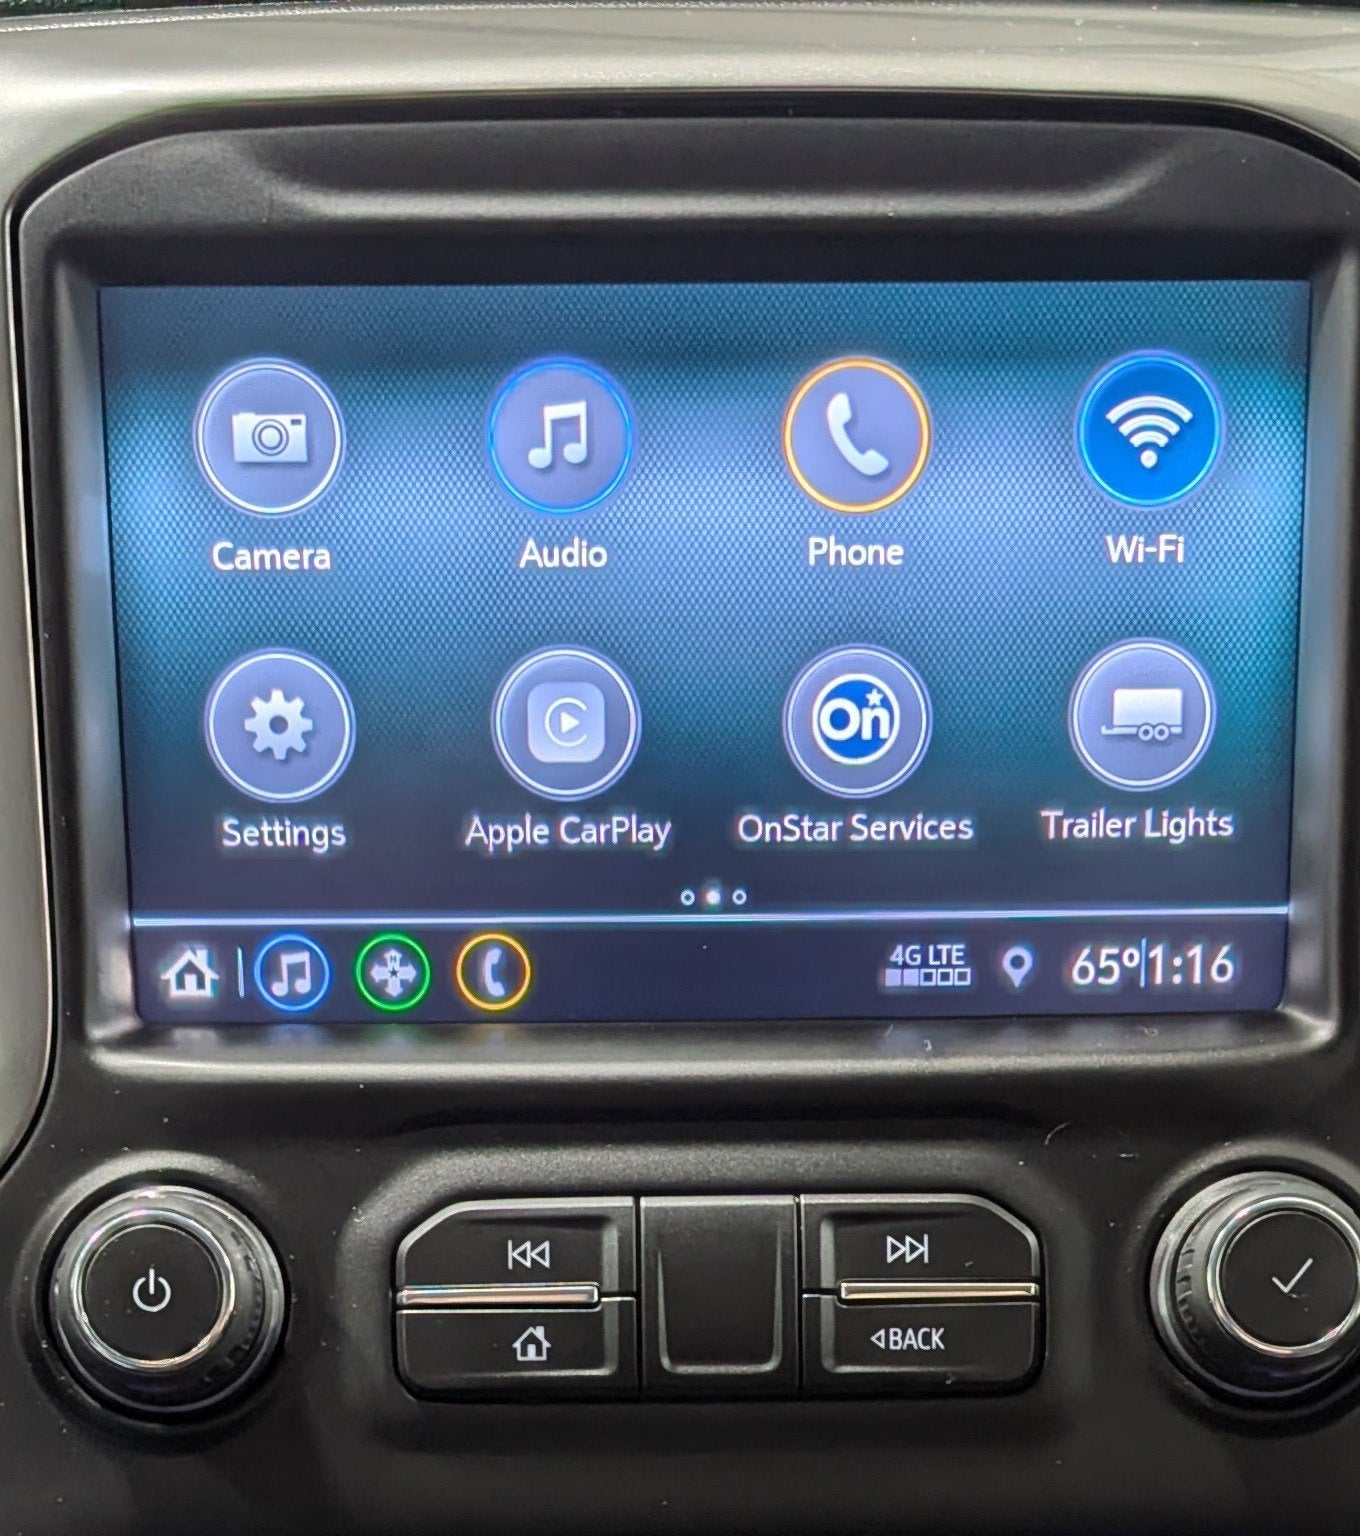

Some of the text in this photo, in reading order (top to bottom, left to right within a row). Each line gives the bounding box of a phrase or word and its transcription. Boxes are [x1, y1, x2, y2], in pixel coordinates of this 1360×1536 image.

[211, 540, 331, 571] Camera
[518, 535, 608, 569] Audio
[808, 534, 905, 566] Phone
[1105, 533, 1185, 564] Wi-Fi
[818, 696, 892, 741] On
[222, 818, 347, 854] Settings
[464, 813, 672, 853] Apple CarPlay
[737, 813, 974, 843] OnStar Services
[1040, 806, 1234, 845] Trailer Lights
[889, 943, 966, 966] 4G LTE
[1148, 944, 1234, 985] 1:16
[888, 1327, 945, 1351] BACK
